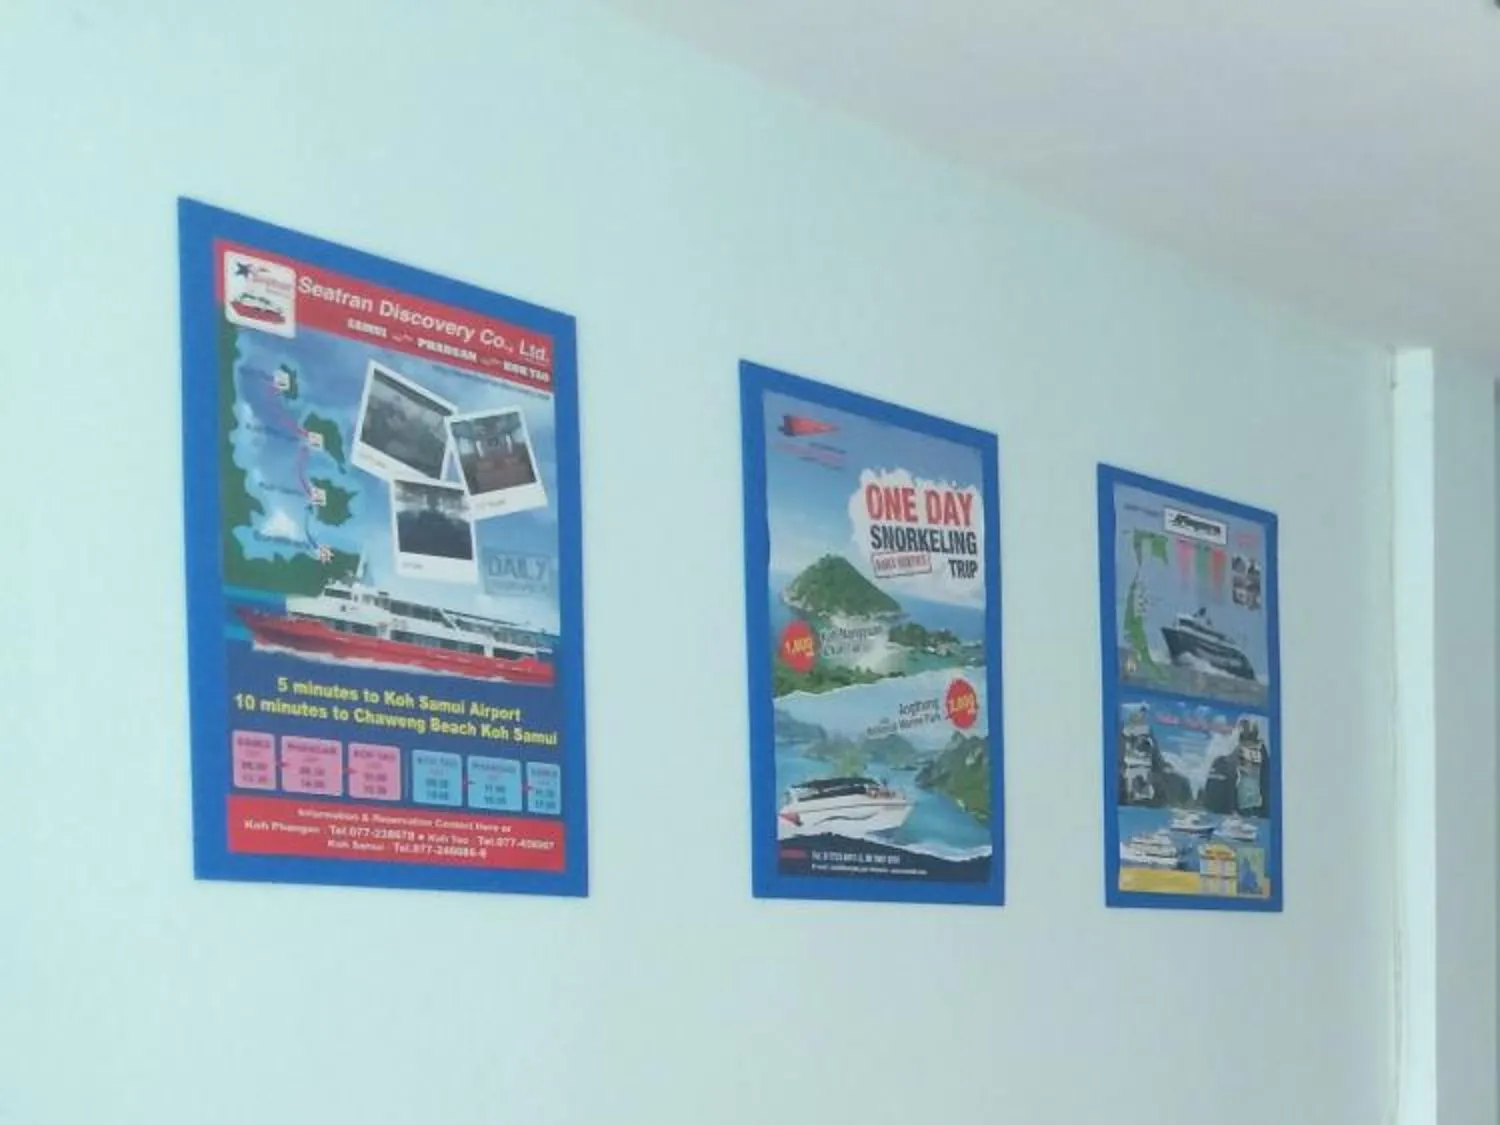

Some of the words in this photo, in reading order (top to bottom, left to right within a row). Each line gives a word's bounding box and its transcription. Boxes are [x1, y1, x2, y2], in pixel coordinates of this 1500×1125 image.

[298, 275, 374, 313] Seatran
[379, 299, 476, 344] Discovery
[866, 484, 918, 522] ONE
[924, 488, 973, 527] DAY
[869, 524, 978, 556] SNORKELING
[948, 559, 979, 579] TRIP
[235, 693, 256, 711] 10
[259, 699, 329, 719] minutes
[332, 706, 350, 721] to
[353, 707, 426, 735] Chaweng
[429, 717, 477, 737] Beach
[480, 723, 510, 741] Koh
[512, 727, 558, 746] Samui
[276, 676, 289, 693] 5
[292, 680, 359, 701] minutes
[363, 688, 381, 704] to
[383, 690, 415, 709] Koh
[418, 695, 465, 715] Samui
[469, 701, 522, 722] Airport
